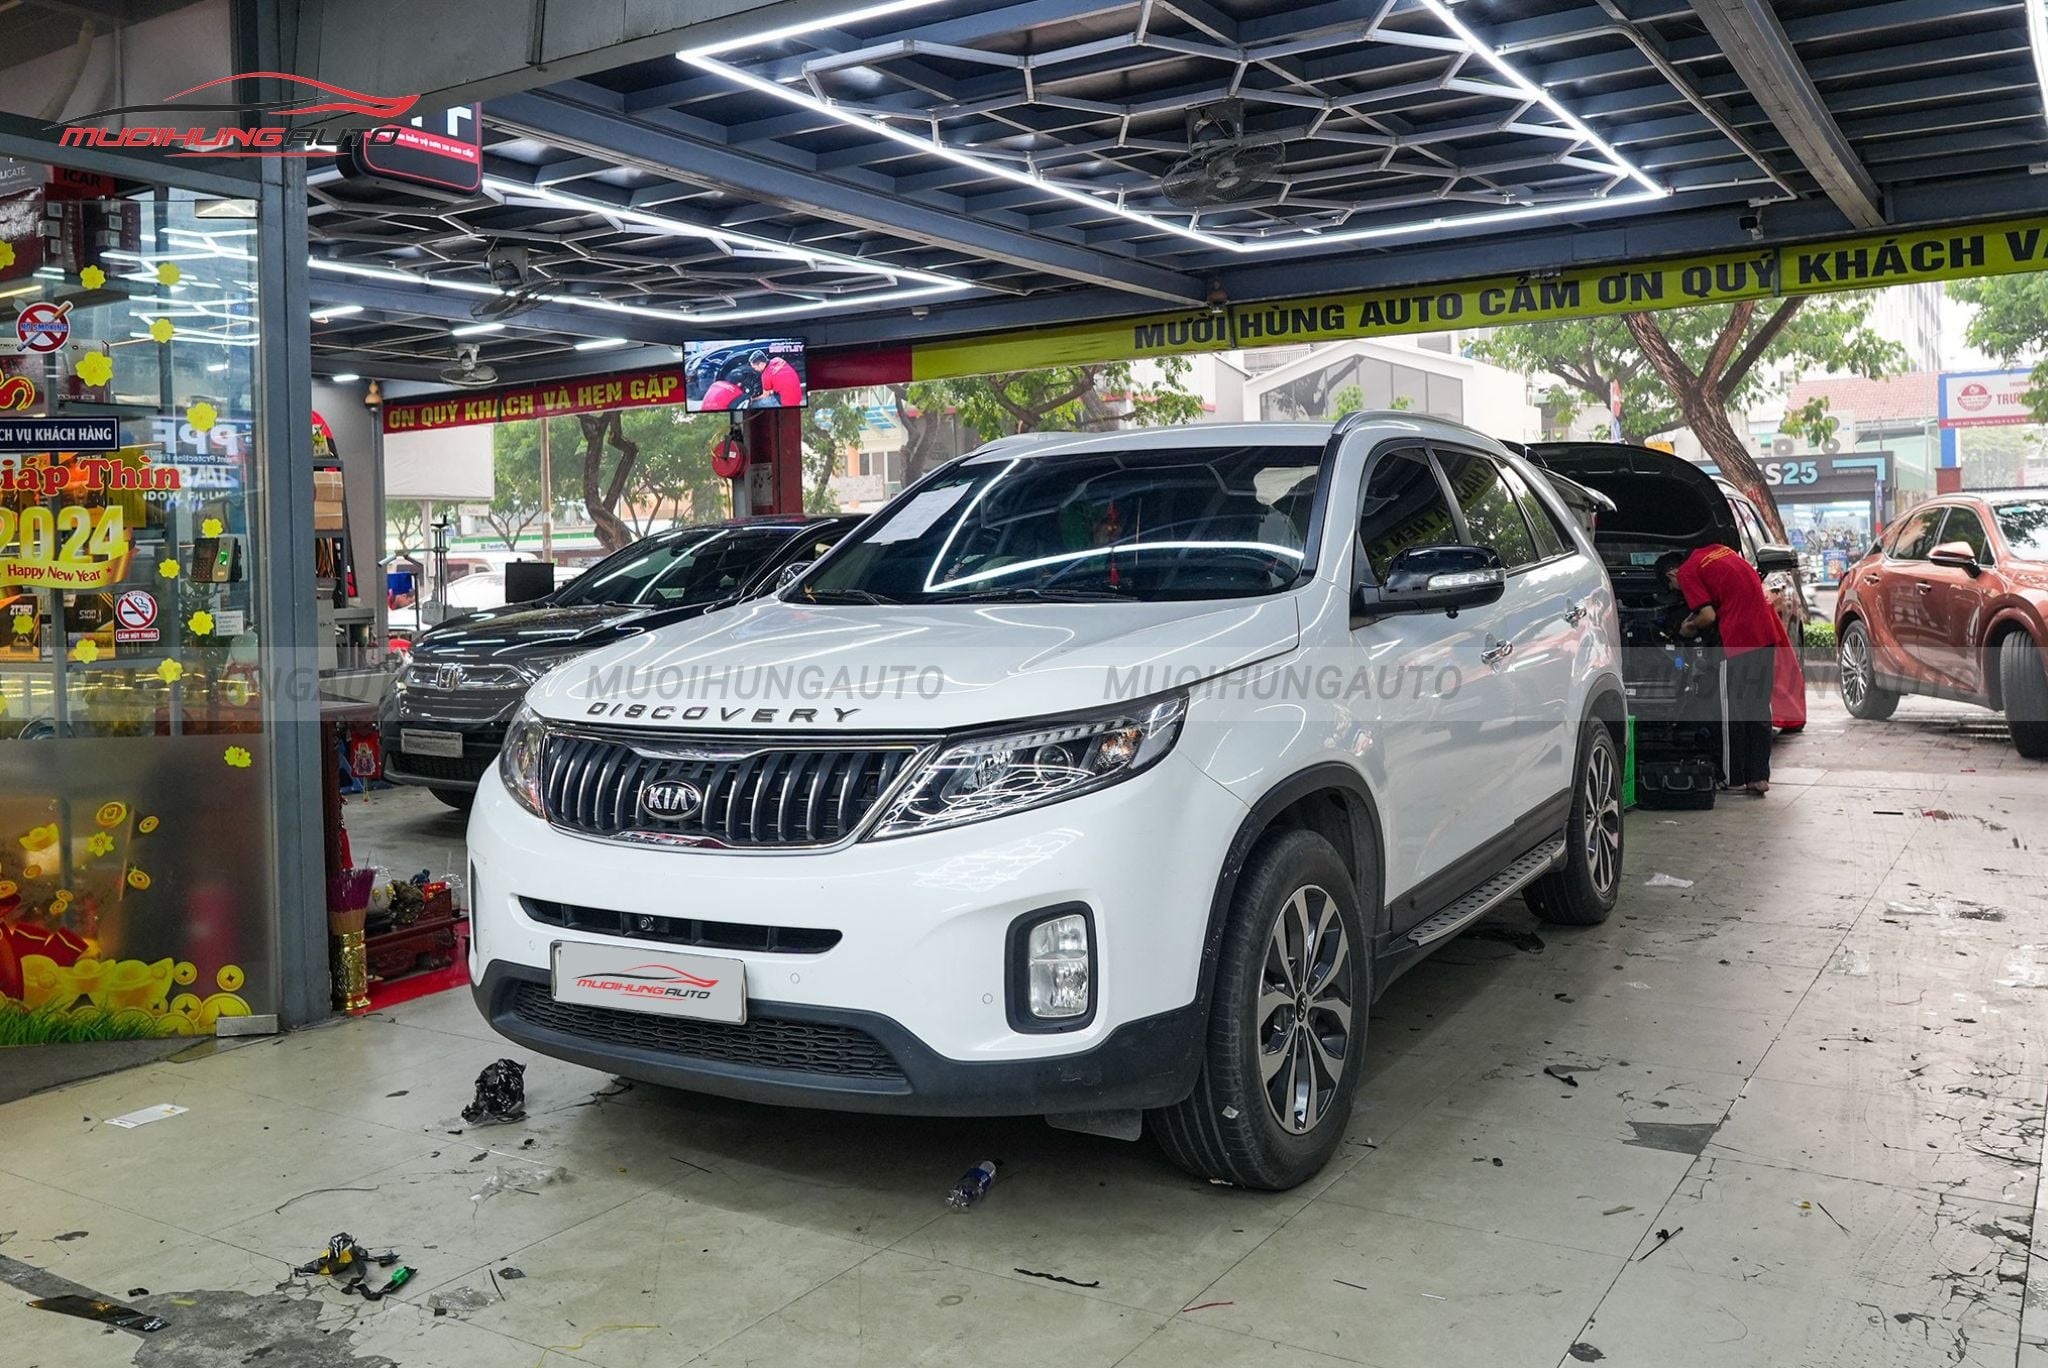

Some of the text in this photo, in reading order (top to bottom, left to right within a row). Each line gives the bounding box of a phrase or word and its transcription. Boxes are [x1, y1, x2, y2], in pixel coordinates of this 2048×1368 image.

[1135, 312, 1226, 349] MƯỜI
[1240, 304, 1346, 339] HÙNG
[1359, 292, 1463, 328] AUTO
[1479, 276, 1580, 316] CẢM
[1596, 271, 1663, 305] ƠN
[1681, 252, 1775, 298] QUÝ
[1799, 234, 1985, 284] KHÁCH
[389, 373, 678, 429] ƠN QUÝ KHÁCH VÀ HẸN GẶP
[16, 428, 32, 444] VỤ
[35, 425, 75, 441] KHÁCH
[79, 425, 112, 441] HÀNG
[0, 454, 182, 496] iáp Thìn
[7, 564, 101, 582] Happy New Year
[586, 702, 863, 724] DISCOVERY
[647, 785, 690, 812] KIA
